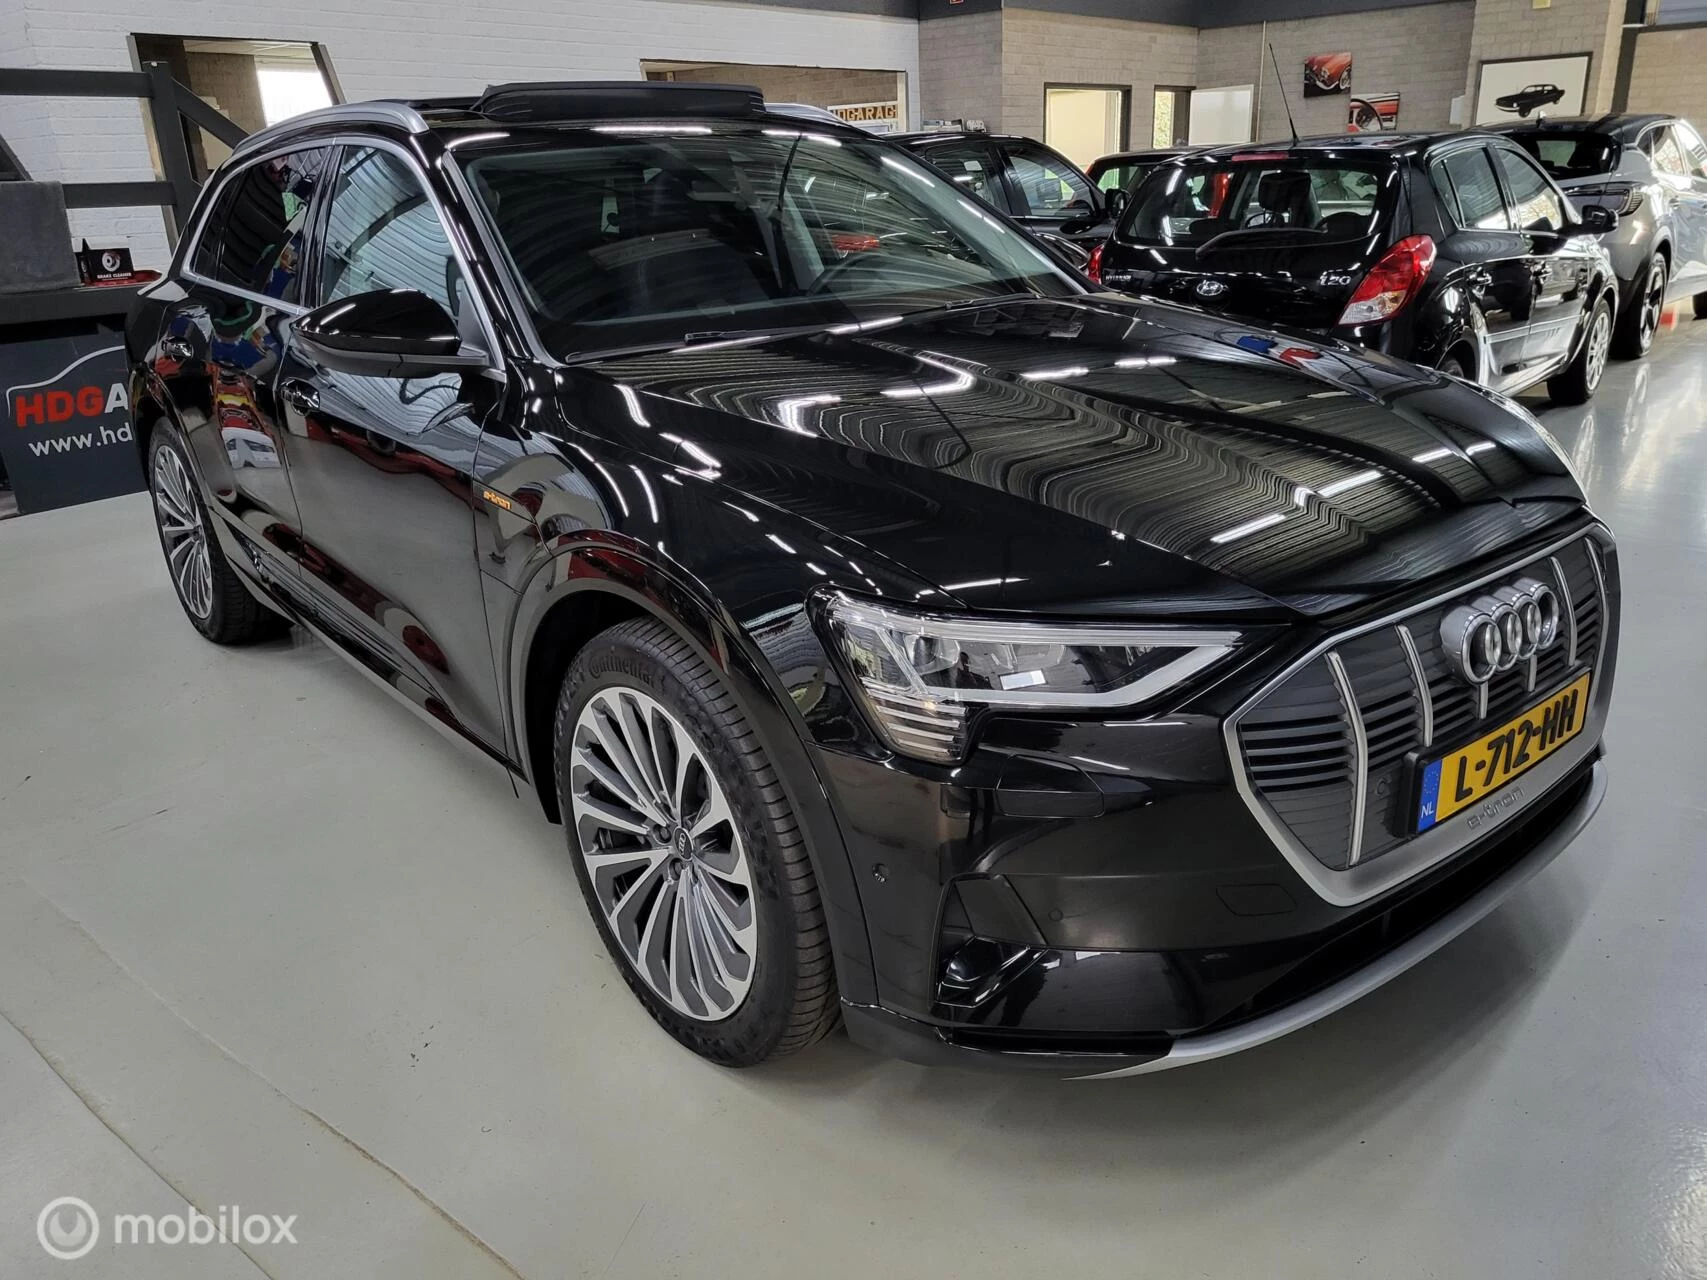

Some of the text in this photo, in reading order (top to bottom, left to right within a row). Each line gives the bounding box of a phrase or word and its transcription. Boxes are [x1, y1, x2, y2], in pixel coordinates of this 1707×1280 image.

[28, 422, 133, 457] www.hd
[483, 490, 511, 511] e-tron
[1455, 688, 1579, 803] L-712-HH
[1420, 801, 1435, 819] NL
[1466, 786, 1524, 829] e-tron
